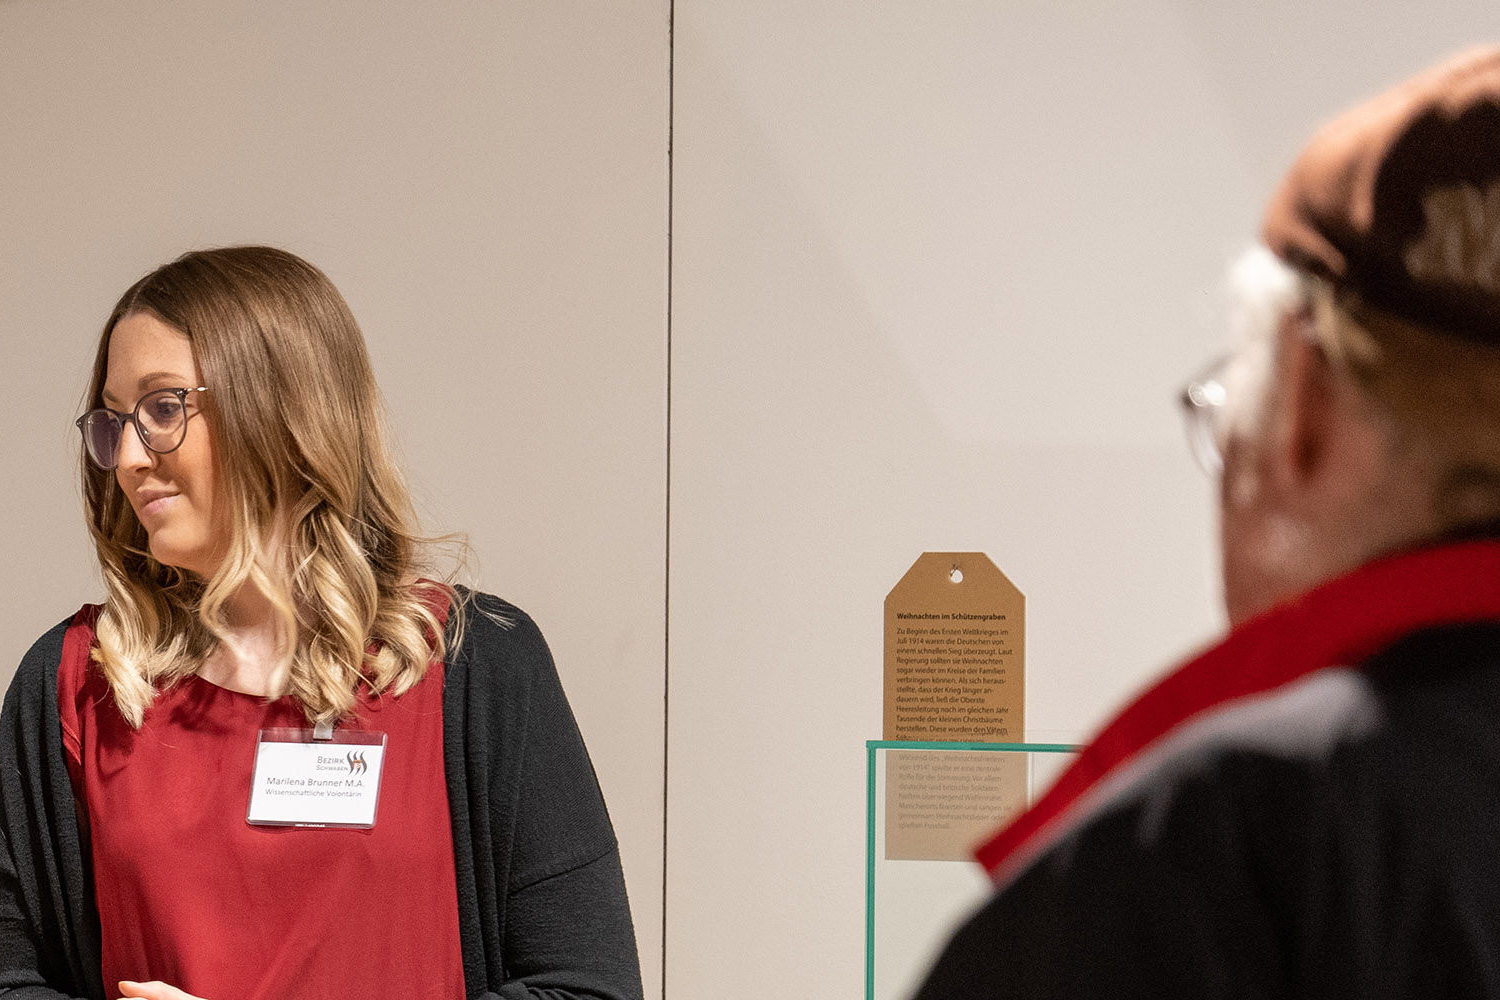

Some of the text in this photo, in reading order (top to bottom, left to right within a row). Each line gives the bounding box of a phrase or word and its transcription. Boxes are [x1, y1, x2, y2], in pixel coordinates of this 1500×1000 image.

[952, 613, 1006, 622] Schützengraben
[907, 628, 929, 636] Beginn
[963, 628, 999, 637] Weltkrieges
[949, 648, 962, 656] Sieg
[964, 648, 997, 657] überzeugt.
[896, 657, 929, 666] Regierung
[896, 676, 931, 685] verbringen
[896, 686, 917, 694] stellte,
[945, 686, 962, 695] Krieg
[963, 686, 983, 695] länger
[920, 696, 936, 704] wird,
[896, 705, 940, 714] Heeresleitung
[967, 706, 995, 715] gleichen
[939, 715, 962, 723] kleinen
[266, 777, 306, 786] Marilena
[307, 778, 343, 786] Brunner
